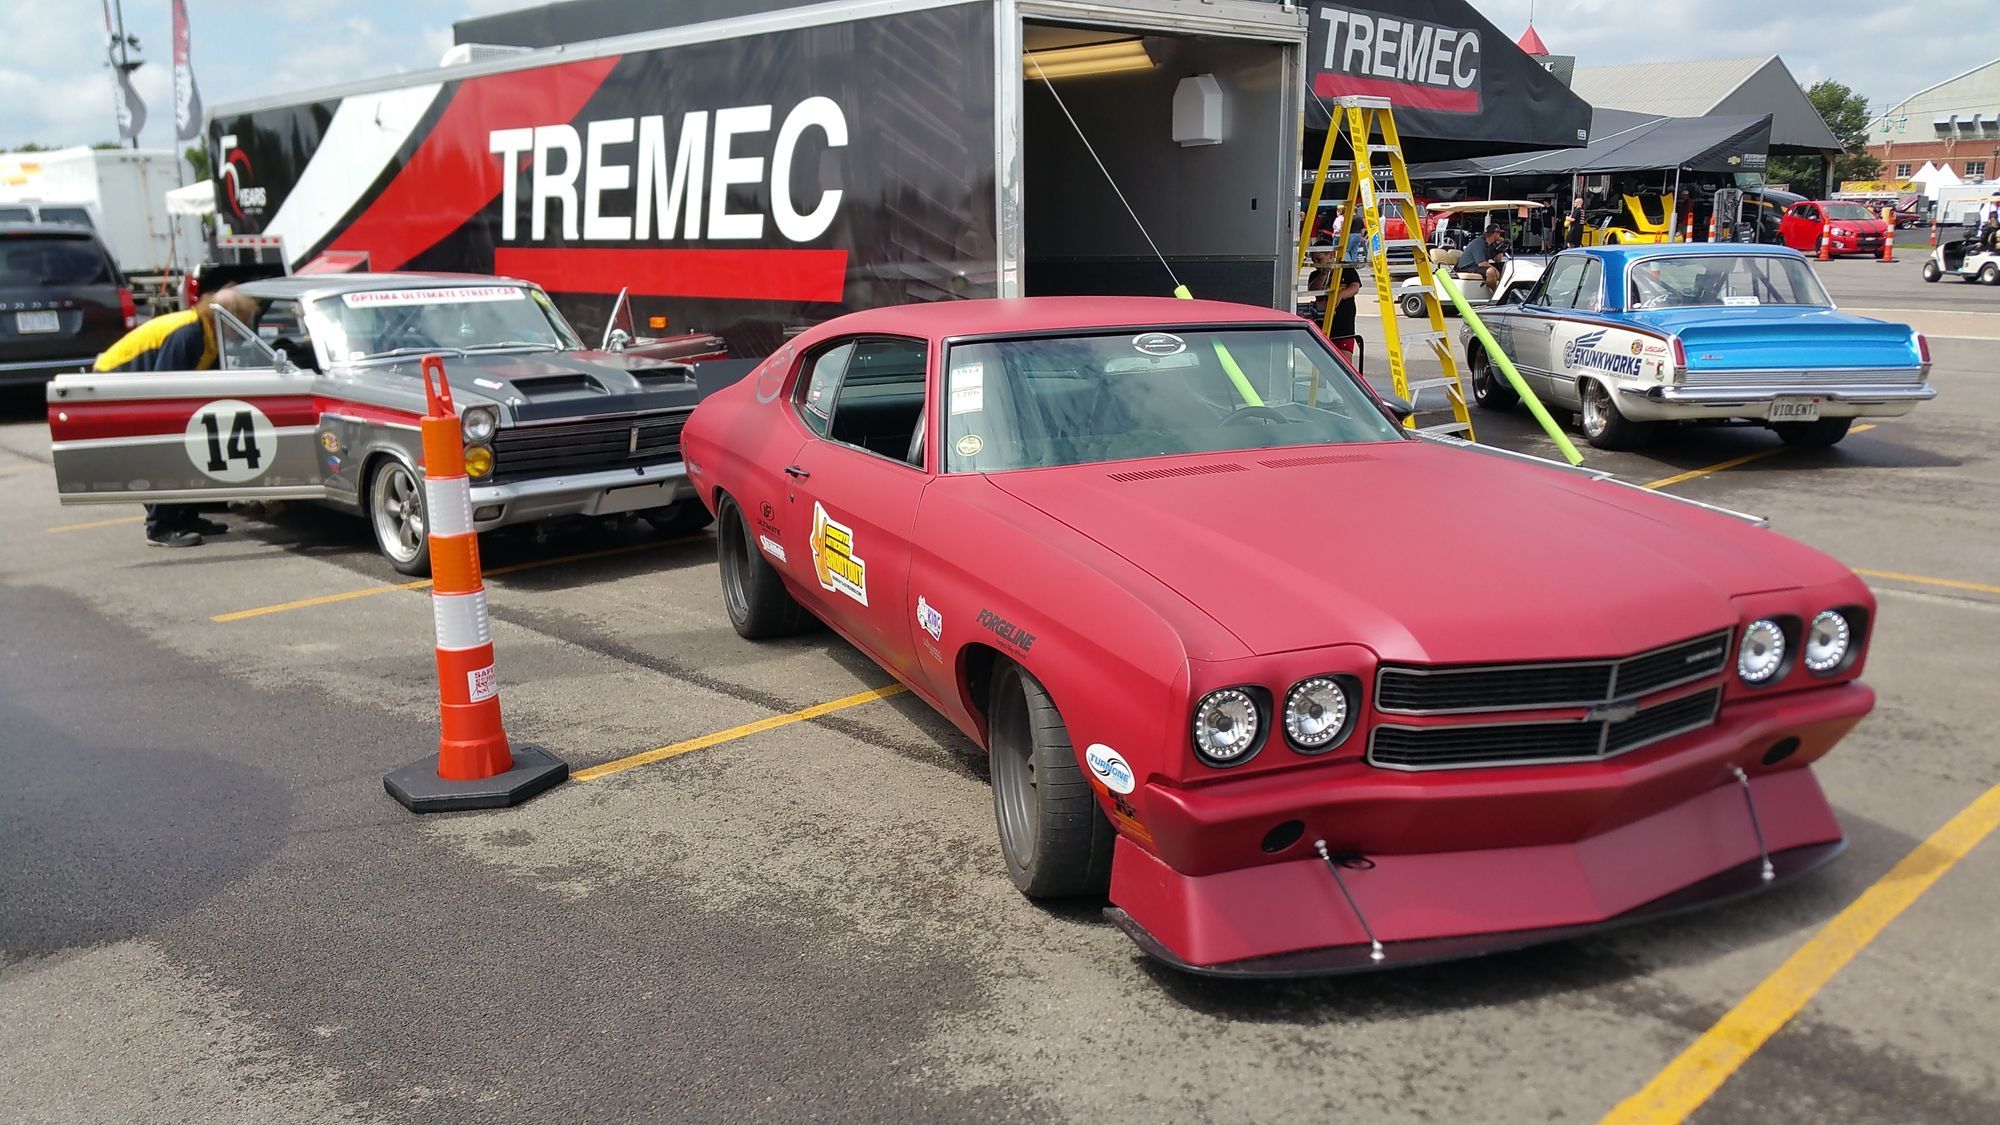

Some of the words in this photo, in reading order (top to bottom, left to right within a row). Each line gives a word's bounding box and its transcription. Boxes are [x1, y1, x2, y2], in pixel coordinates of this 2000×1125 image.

[1320, 7, 1480, 88] TREMEC
[489, 96, 848, 242] TREMEC
[239, 187, 267, 208] YEARS
[351, 293, 398, 303] OPTIMA
[401, 289, 456, 300] ULTIMATE
[459, 287, 496, 298] STREET
[497, 286, 518, 296] CAR
[1574, 347, 1642, 376] SKUNKWORKS
[1773, 403, 1814, 416] VIOLENT
[201, 411, 261, 472] 14
[825, 551, 863, 589] SHOOTOUT
[976, 608, 1036, 652] FORGELINE
